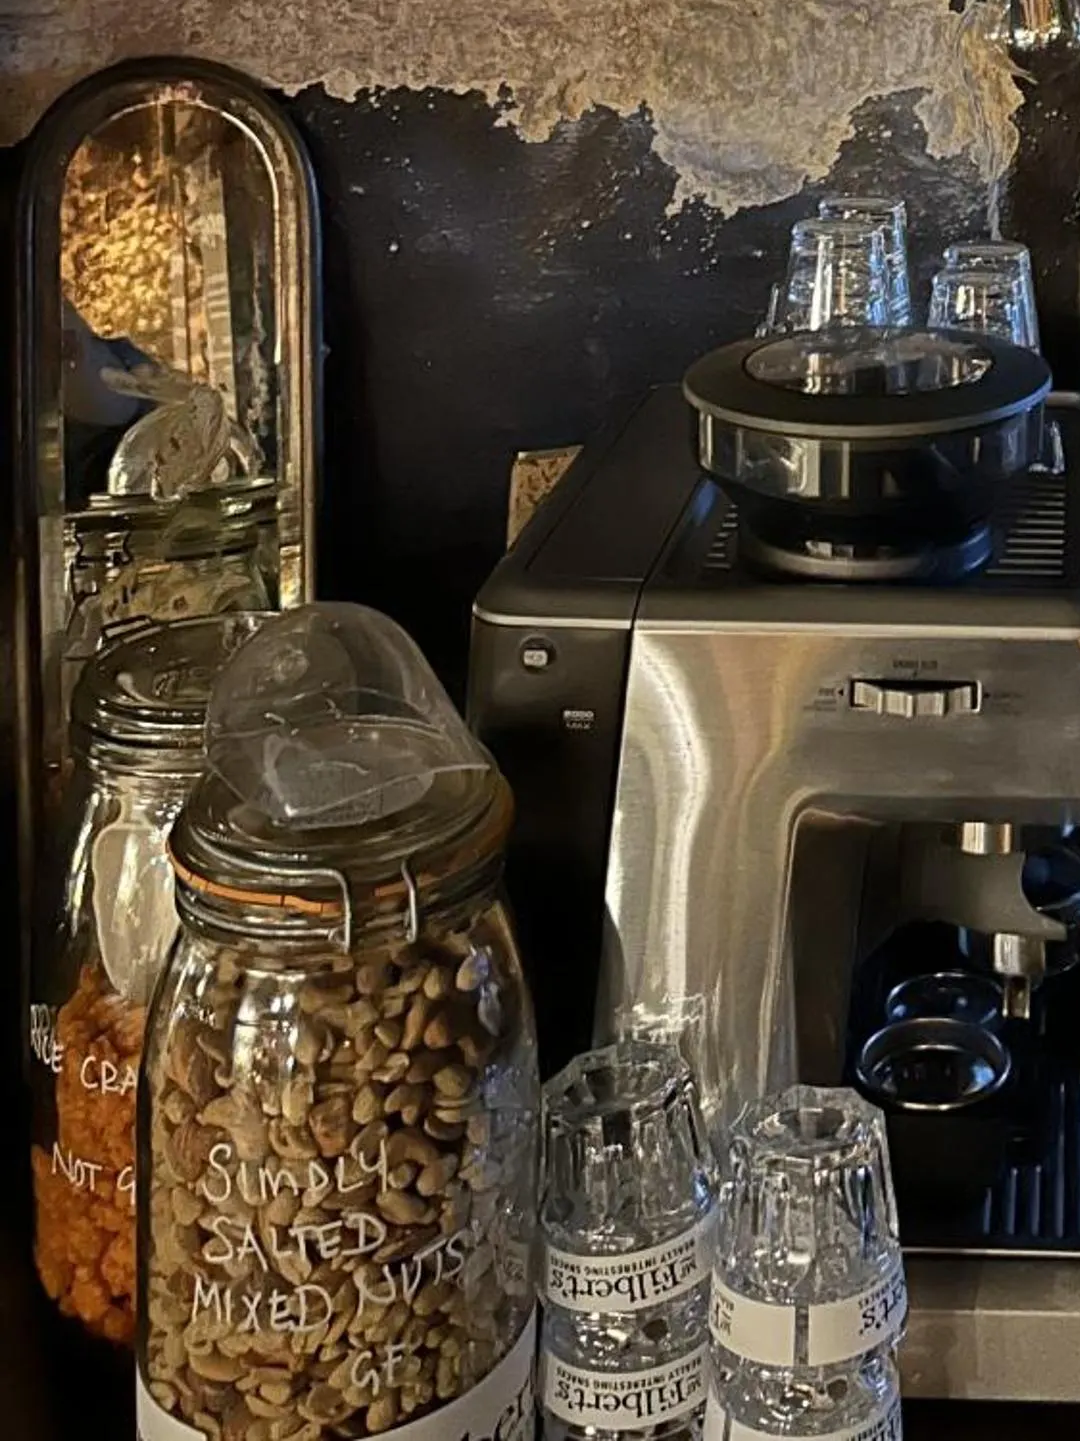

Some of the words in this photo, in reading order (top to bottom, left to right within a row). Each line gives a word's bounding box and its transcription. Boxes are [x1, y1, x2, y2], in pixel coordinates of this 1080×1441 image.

[51, 1140, 103, 1192] NOT
[203, 1211, 388, 1274] SALTED
[191, 1271, 333, 1333] MIXED
[353, 1229, 466, 1314] NUTS
[550, 1259, 681, 1304] Filbert's
[554, 1379, 689, 1419] Filbert's
